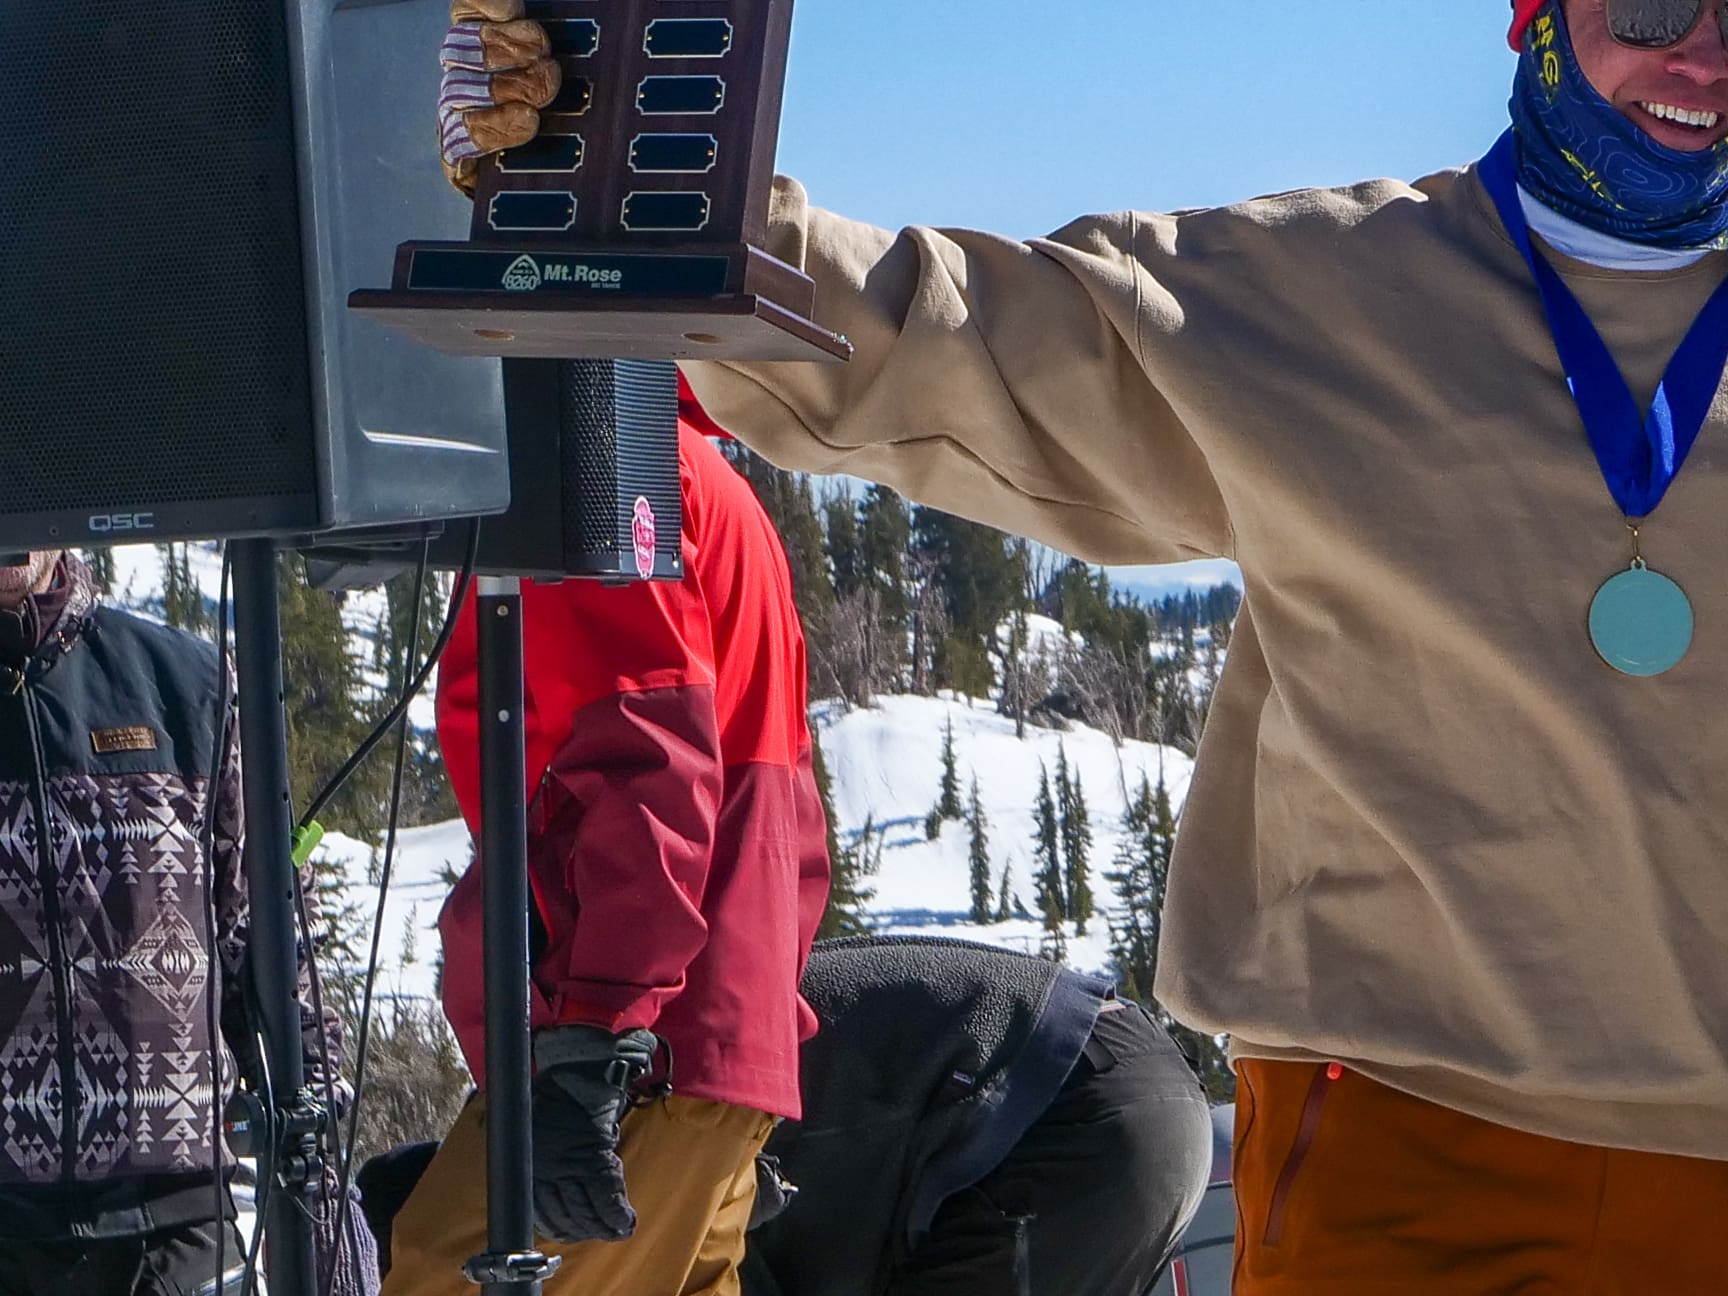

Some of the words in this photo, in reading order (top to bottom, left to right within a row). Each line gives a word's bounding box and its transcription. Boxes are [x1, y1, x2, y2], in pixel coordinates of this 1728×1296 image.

[544, 264, 573, 281] Mt.
[574, 265, 622, 282] Rose
[88, 512, 154, 532] QSC
